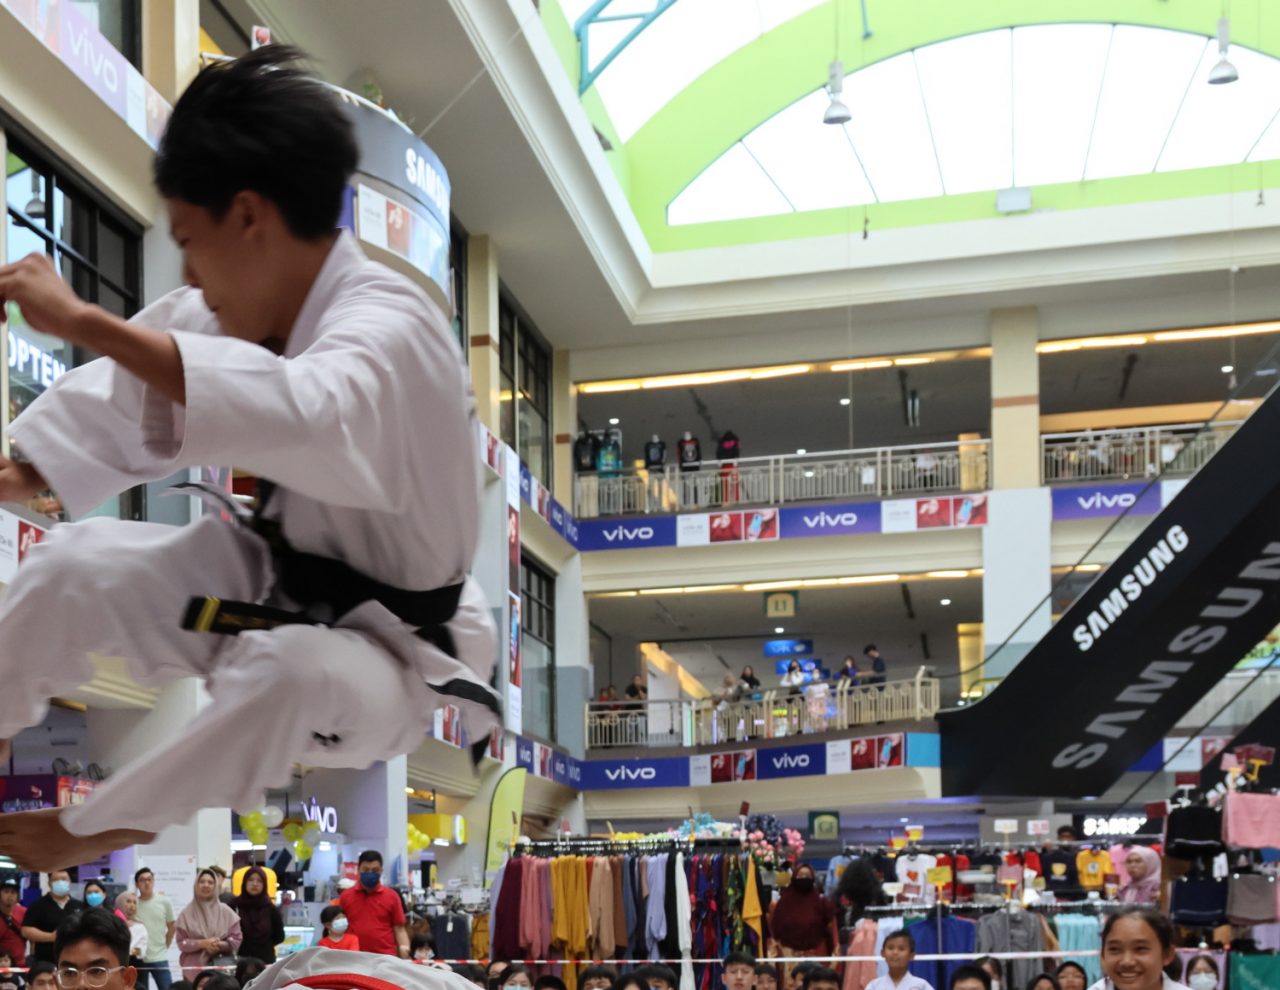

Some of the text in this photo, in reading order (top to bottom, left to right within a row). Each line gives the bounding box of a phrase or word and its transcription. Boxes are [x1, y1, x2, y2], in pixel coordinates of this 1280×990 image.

[67, 20, 118, 93] vivo
[1076, 492, 1136, 510] vivo
[803, 510, 858, 528] vivo
[602, 525, 655, 541] vivo
[1072, 524, 1190, 652] SAMSUNG
[772, 752, 810, 769] vivo
[604, 765, 657, 780] vivo
